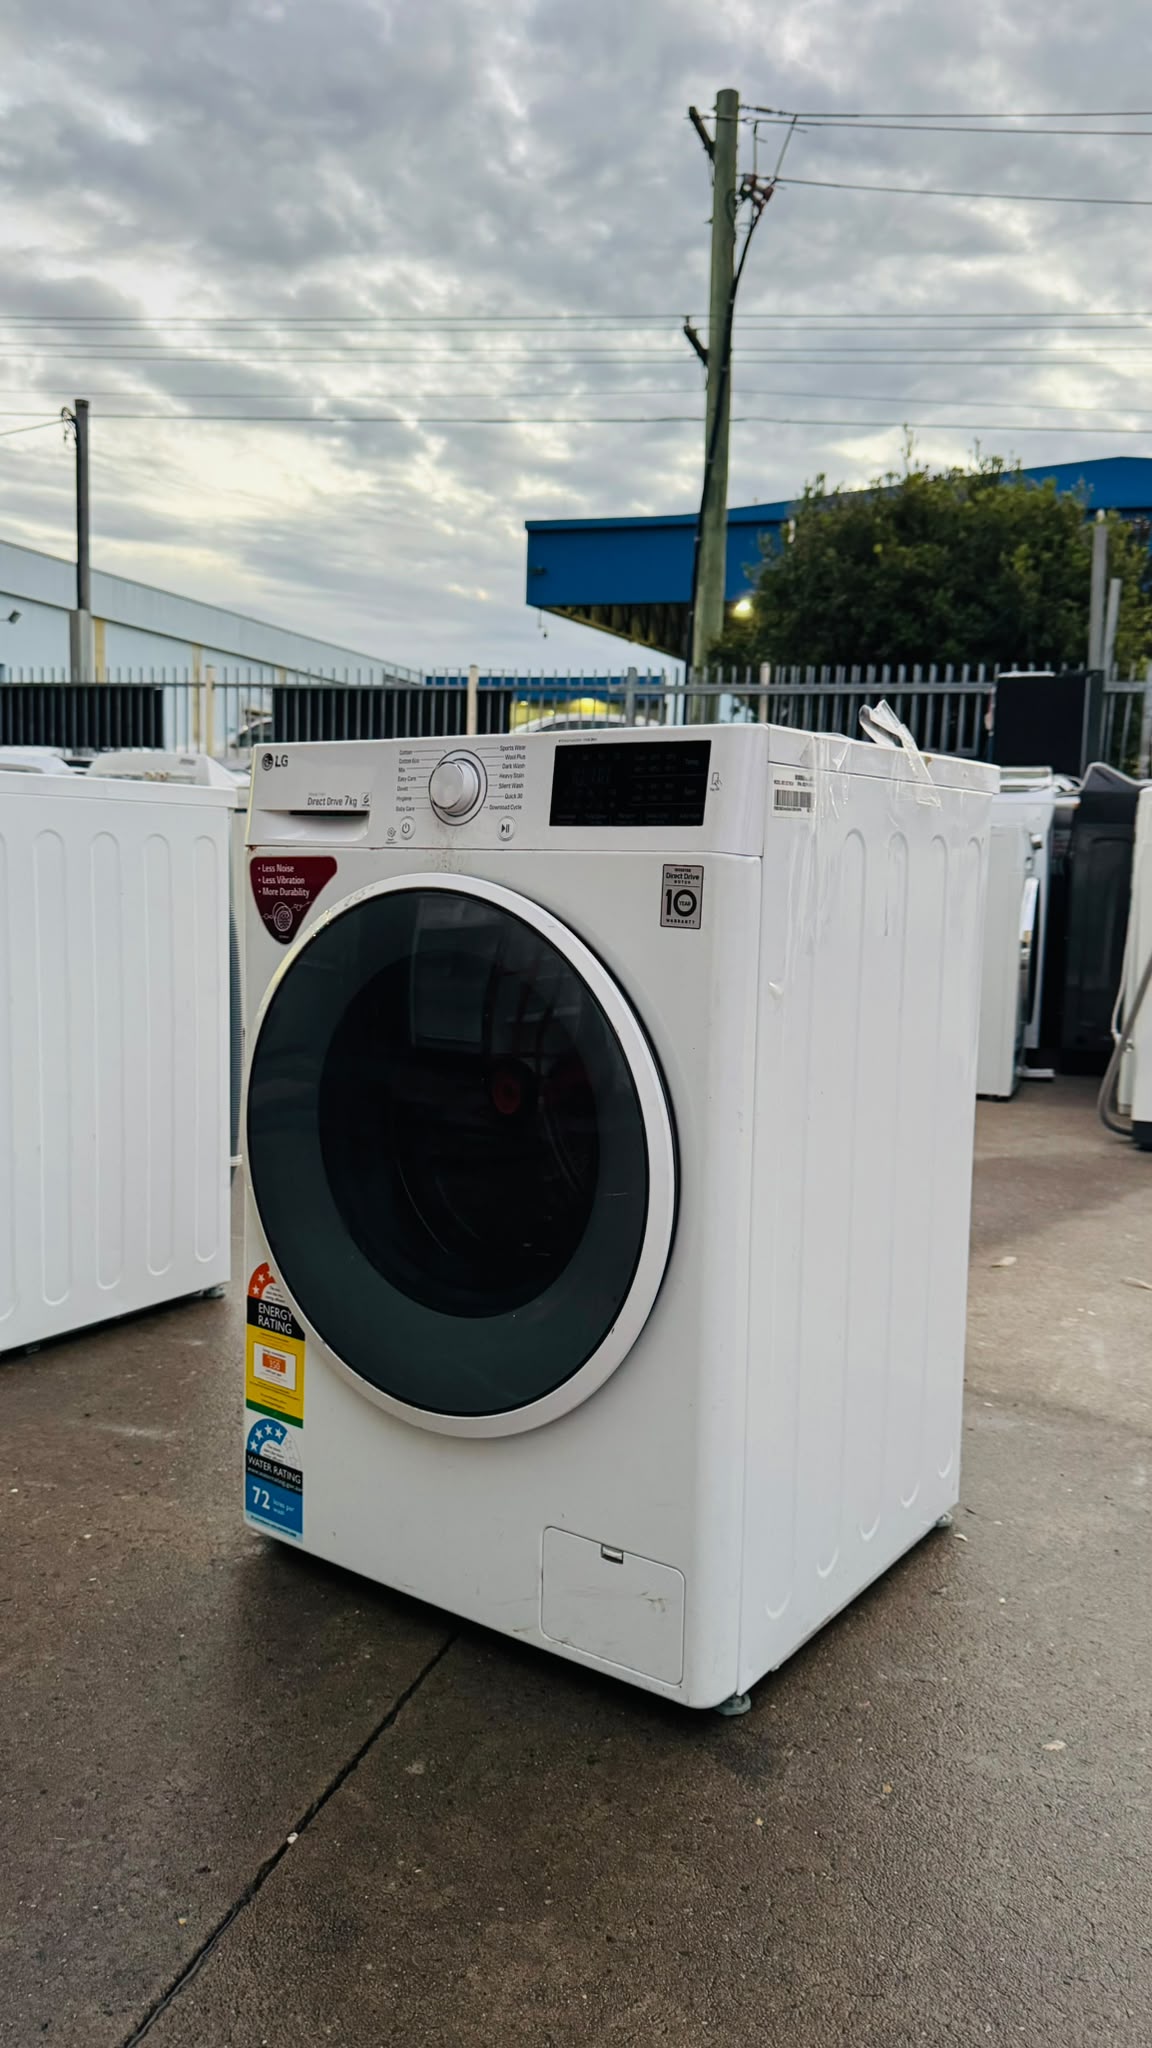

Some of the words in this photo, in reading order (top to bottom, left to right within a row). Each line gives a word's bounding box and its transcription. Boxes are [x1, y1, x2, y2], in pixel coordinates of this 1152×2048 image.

[275, 754, 289, 768] LG
[307, 797, 326, 806] Direct
[327, 797, 343, 806] Drive
[344, 795, 357, 808] 7kg
[262, 864, 275, 872] Less
[277, 864, 294, 872] Noise
[262, 876, 276, 884] Less
[277, 876, 305, 884] Vibration
[666, 872, 683, 880] Direct
[684, 873, 700, 881] Drive
[262, 888, 278, 896] More
[280, 888, 310, 899] Durability
[666, 889, 697, 917] 10
[258, 1303, 293, 1322] ENERGY
[258, 1315, 292, 1335] RATING
[247, 1455, 272, 1473] WATER
[273, 1466, 301, 1484] RATING
[252, 1485, 271, 1511] 72
